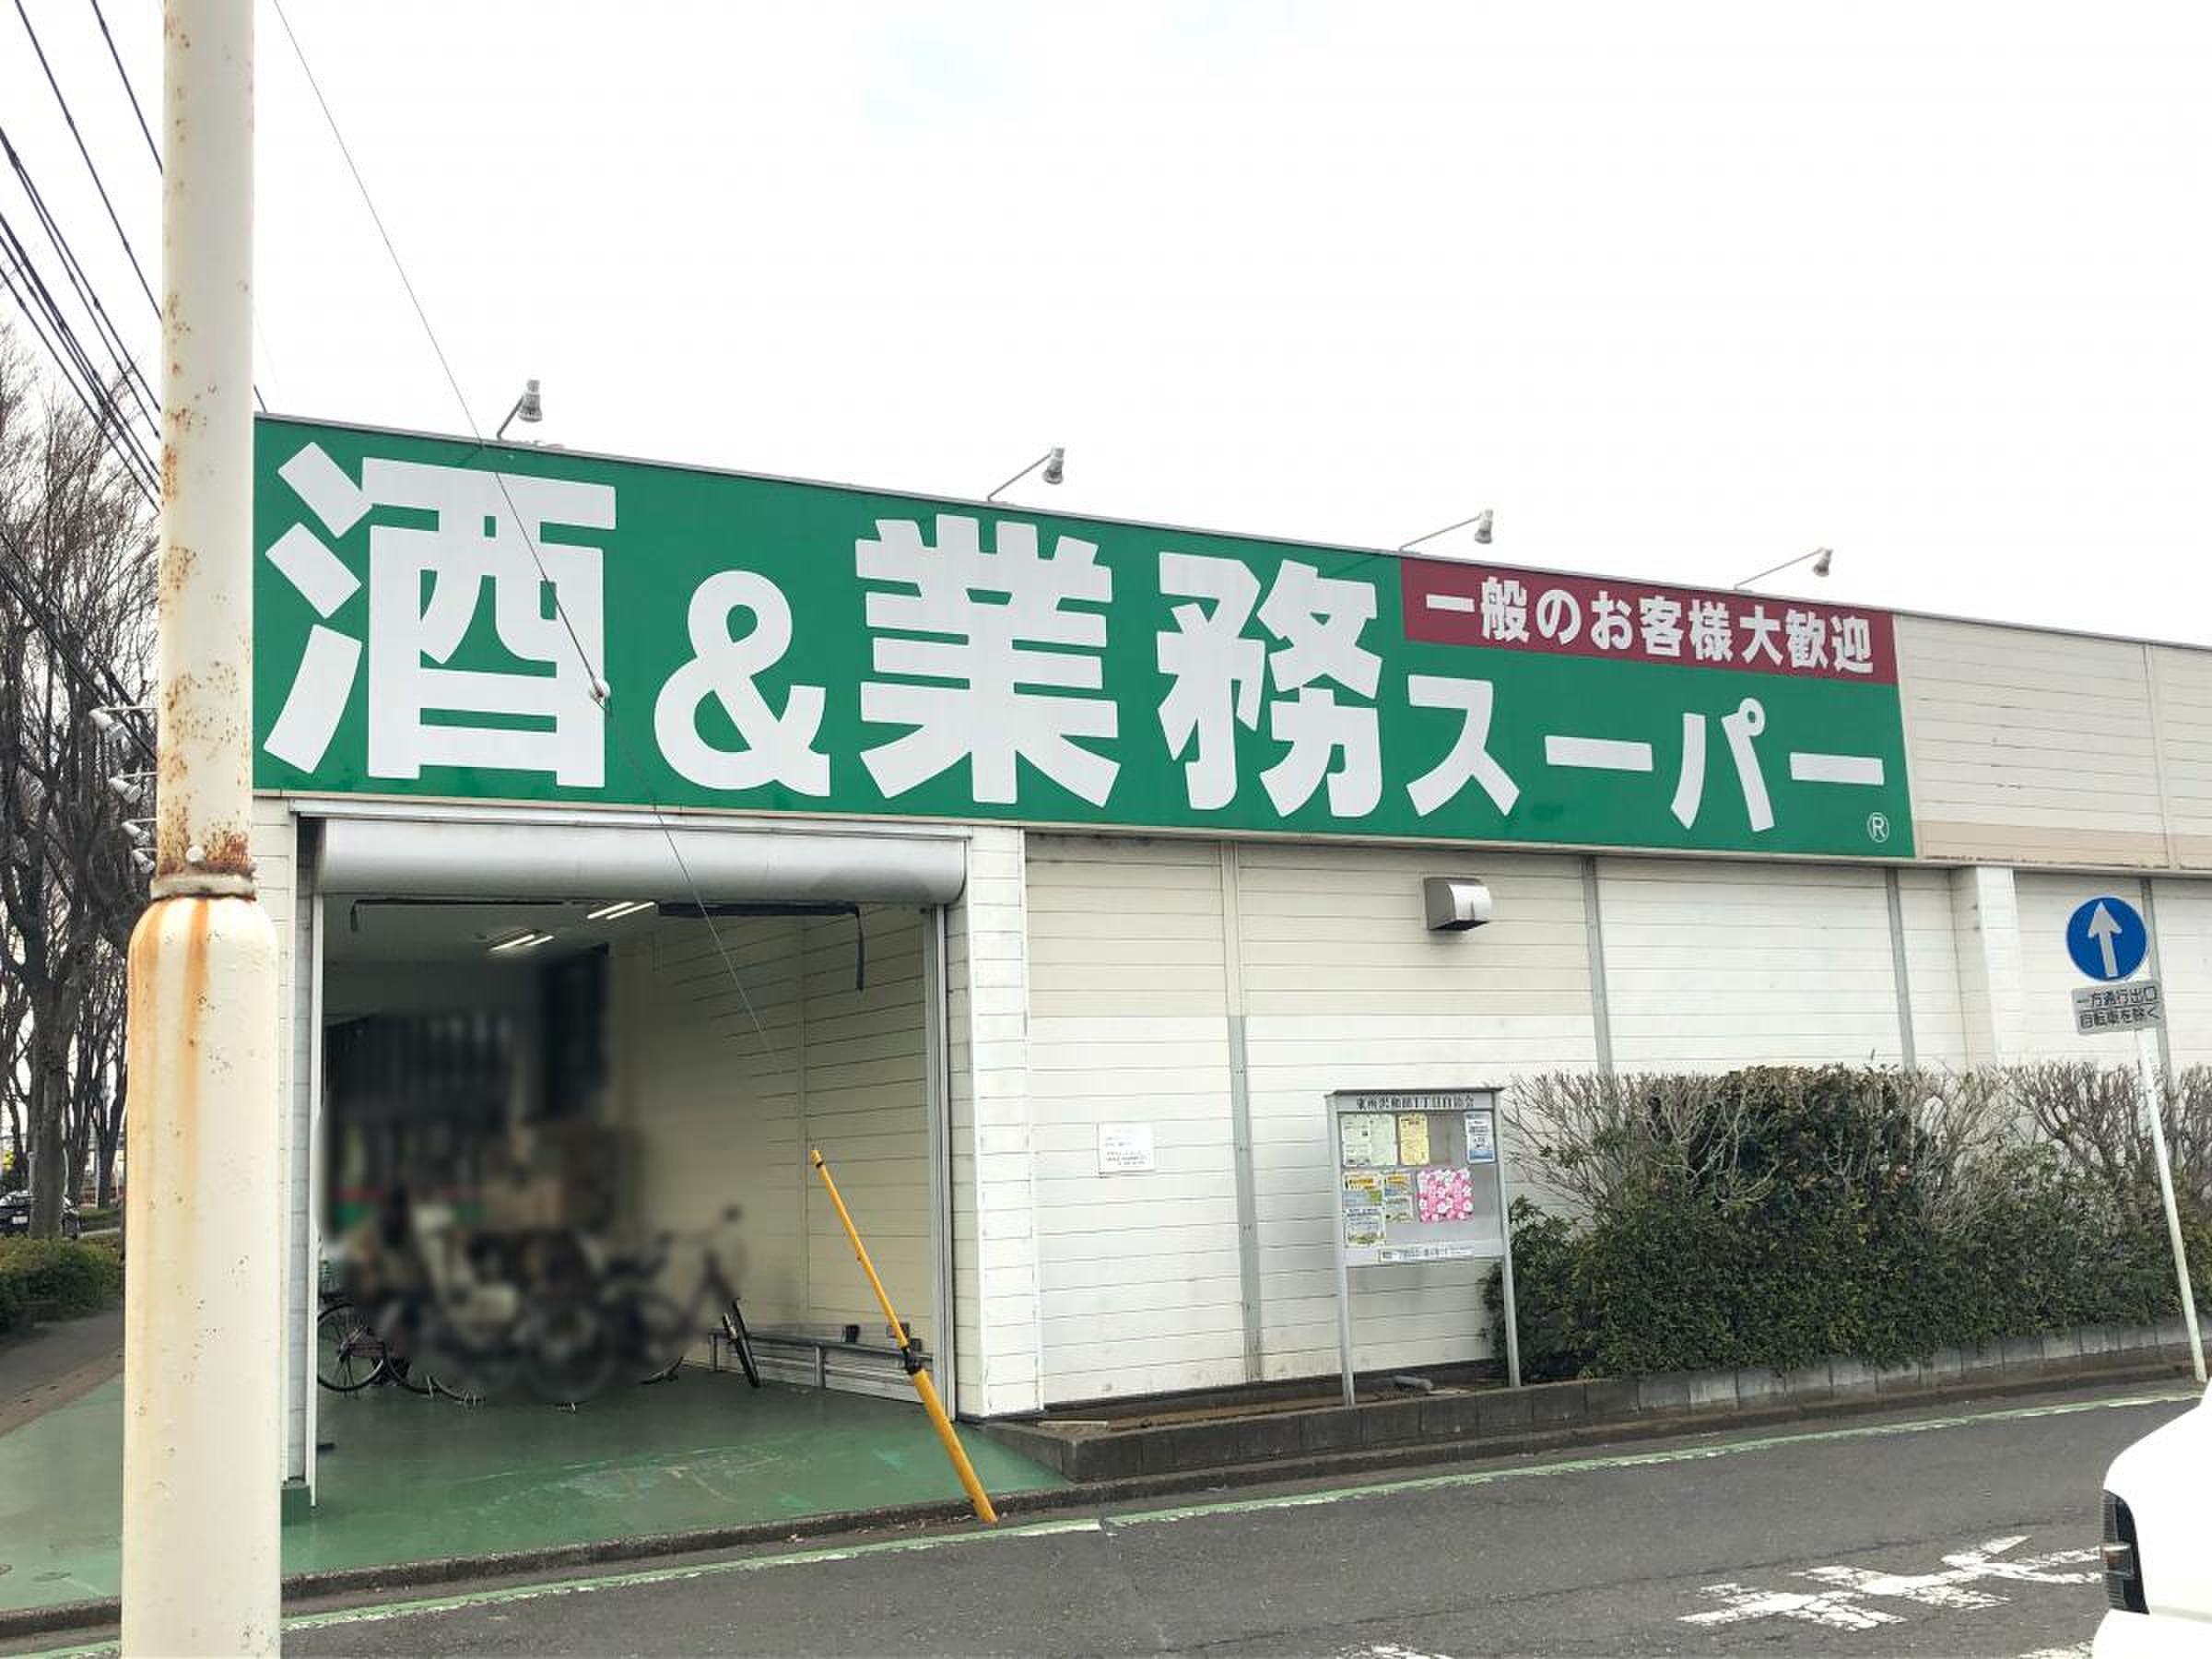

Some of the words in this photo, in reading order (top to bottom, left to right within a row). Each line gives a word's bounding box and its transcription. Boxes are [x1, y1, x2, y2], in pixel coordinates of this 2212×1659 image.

[1426, 576, 1875, 674] 一般のお客様大歓迎
[2077, 985, 2158, 1007] 一方通行出口
[2079, 1006, 2161, 1029] 自転車を除く
